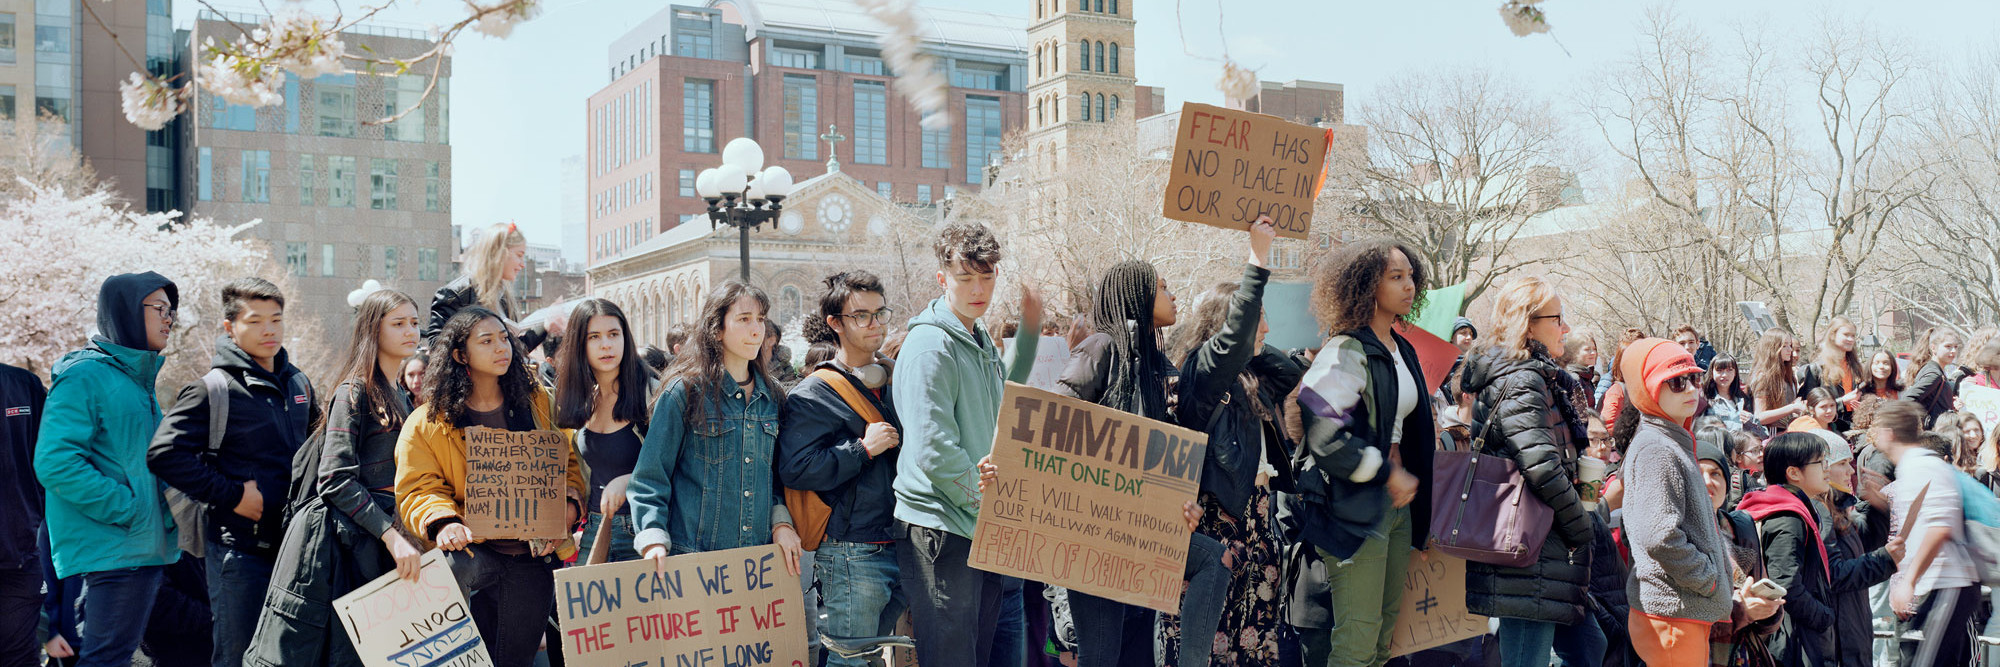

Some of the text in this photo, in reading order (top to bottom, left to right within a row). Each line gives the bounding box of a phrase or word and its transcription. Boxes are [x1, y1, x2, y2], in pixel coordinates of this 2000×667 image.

[1190, 111, 1310, 164] FEAR HAS
[1184, 149, 1314, 199] NO PLACE IN
[1177, 185, 1310, 233] OUR SCHOOLS
[470, 431, 560, 446] WHEN I SAID
[533, 446, 559, 460] DIE
[1010, 396, 1043, 443] I
[1040, 401, 1122, 462] HAVE
[1117, 424, 1140, 469] A
[466, 474, 507, 487] CLASS,
[516, 473, 557, 487] DIDN'T
[466, 486, 557, 499] MEAN IT THIS
[515, 461, 528, 471] TO
[530, 460, 567, 476] MATH
[1021, 447, 1144, 498] THAT ONE DAY,
[993, 499, 1025, 518] OUR
[1104, 527, 1137, 547] AGAIN
[1138, 538, 1186, 563] WITHOUT
[994, 478, 1184, 537] WE WILL WALK THROUGH
[976, 521, 1047, 574] FEAR
[1051, 541, 1080, 580] OF
[1082, 547, 1146, 594] BEING
[565, 552, 774, 620] HOW CAN WE BE
[567, 598, 786, 655] THE FUTURE IF WE
[722, 640, 773, 667] LONG
